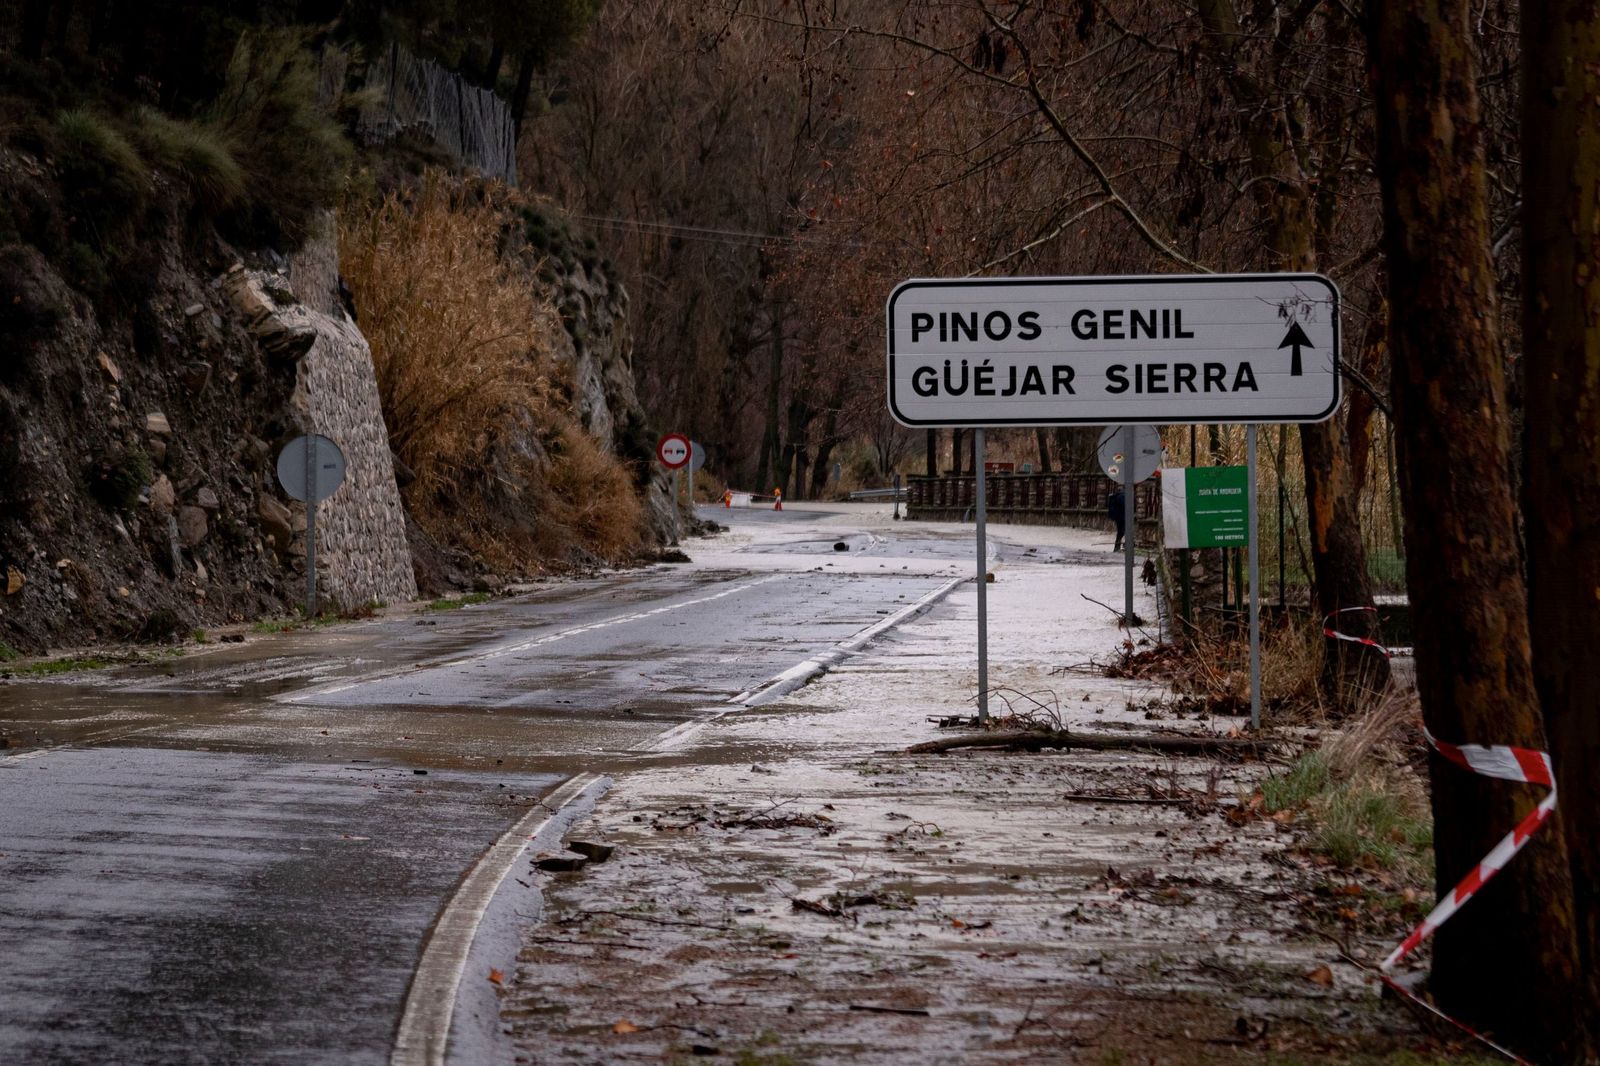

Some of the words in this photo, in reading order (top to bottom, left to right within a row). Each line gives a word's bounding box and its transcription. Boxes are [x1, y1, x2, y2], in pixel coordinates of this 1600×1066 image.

[912, 311, 1042, 342] PINOS
[1070, 309, 1195, 340] GENIL
[911, 359, 1077, 397] GÜÉJAR
[1104, 362, 1259, 394] SIERRA
